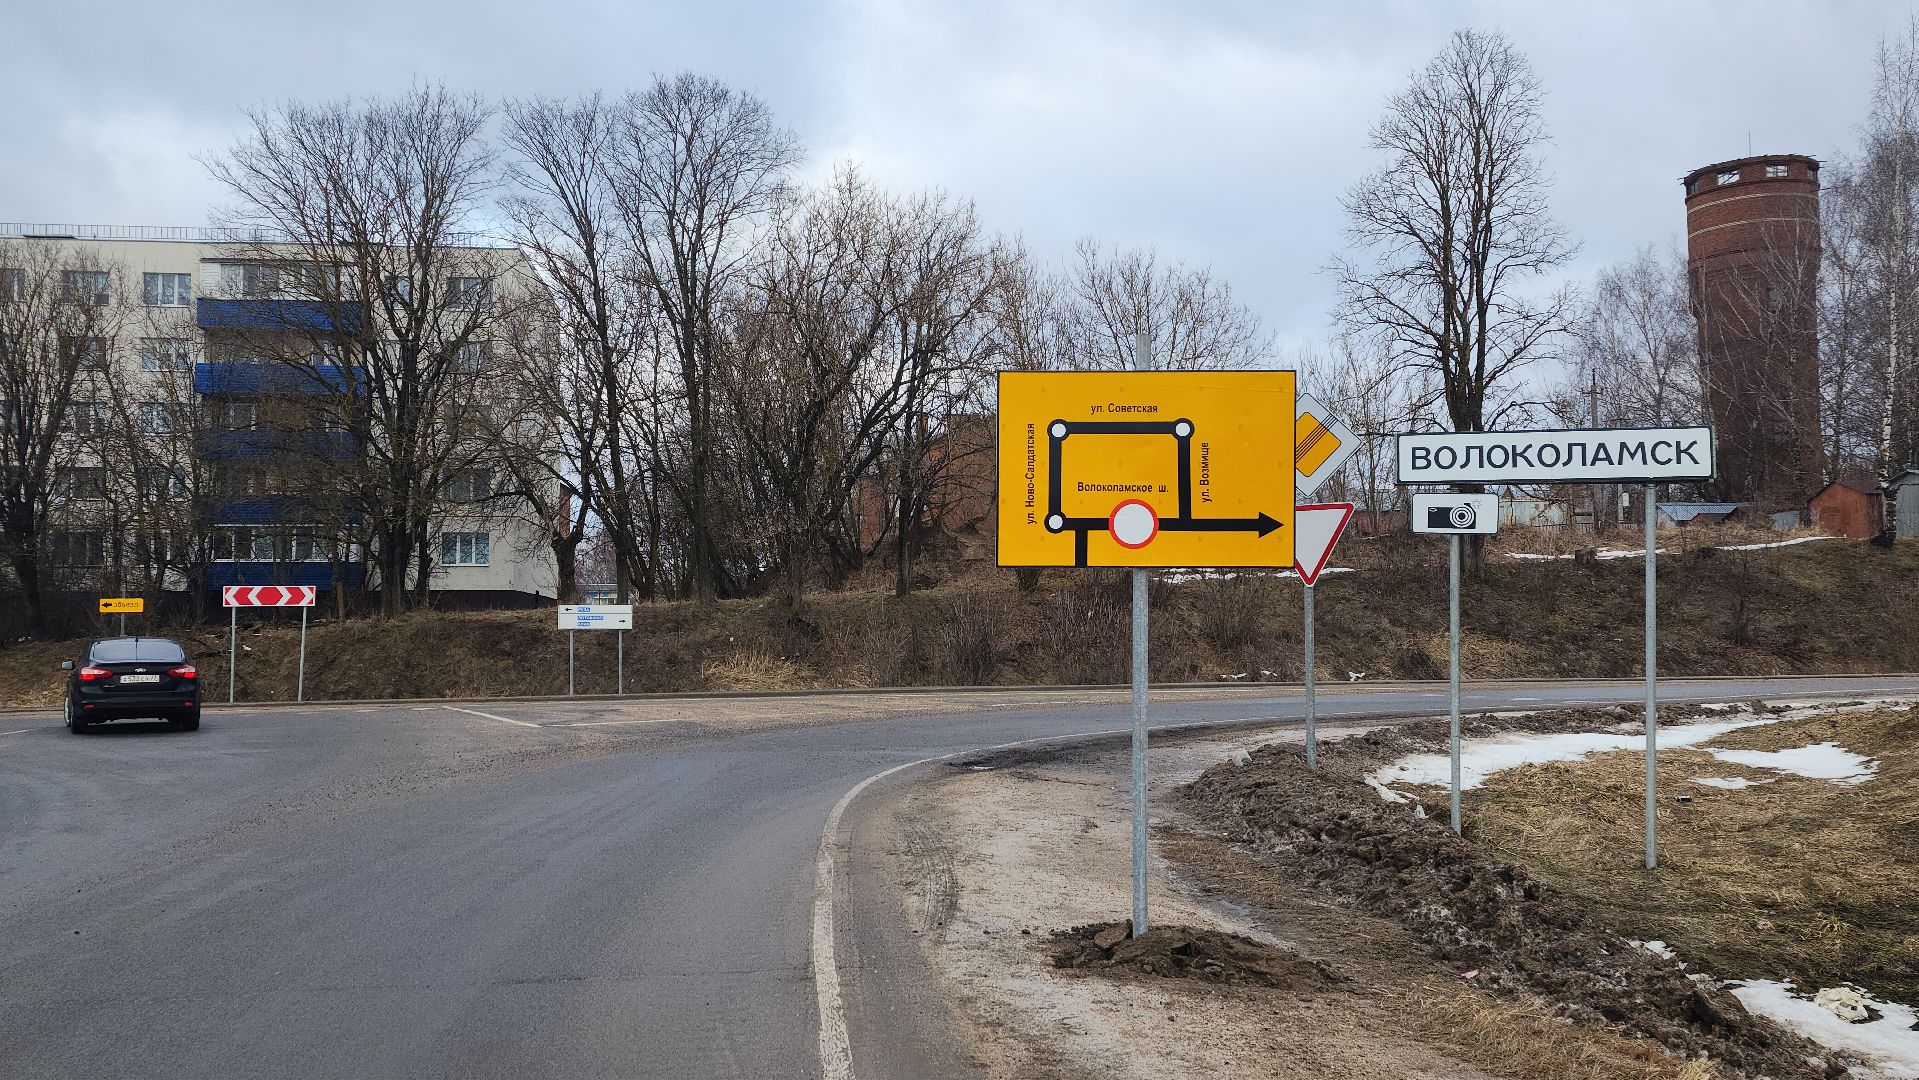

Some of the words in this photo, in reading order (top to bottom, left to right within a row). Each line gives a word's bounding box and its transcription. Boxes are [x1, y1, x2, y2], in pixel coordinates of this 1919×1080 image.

[1091, 404, 1105, 414] ул.
[1108, 403, 1158, 413] Советская
[1411, 439, 1701, 471] ВОЛОКОЛАМСК
[1025, 423, 1036, 508] Ново-Салдатская
[1199, 442, 1210, 486] Возмище
[1077, 482, 1153, 492] Волоколамское
[1159, 484, 1169, 492] ш.
[1202, 488, 1212, 504] ул.
[1027, 510, 1037, 525] ул.
